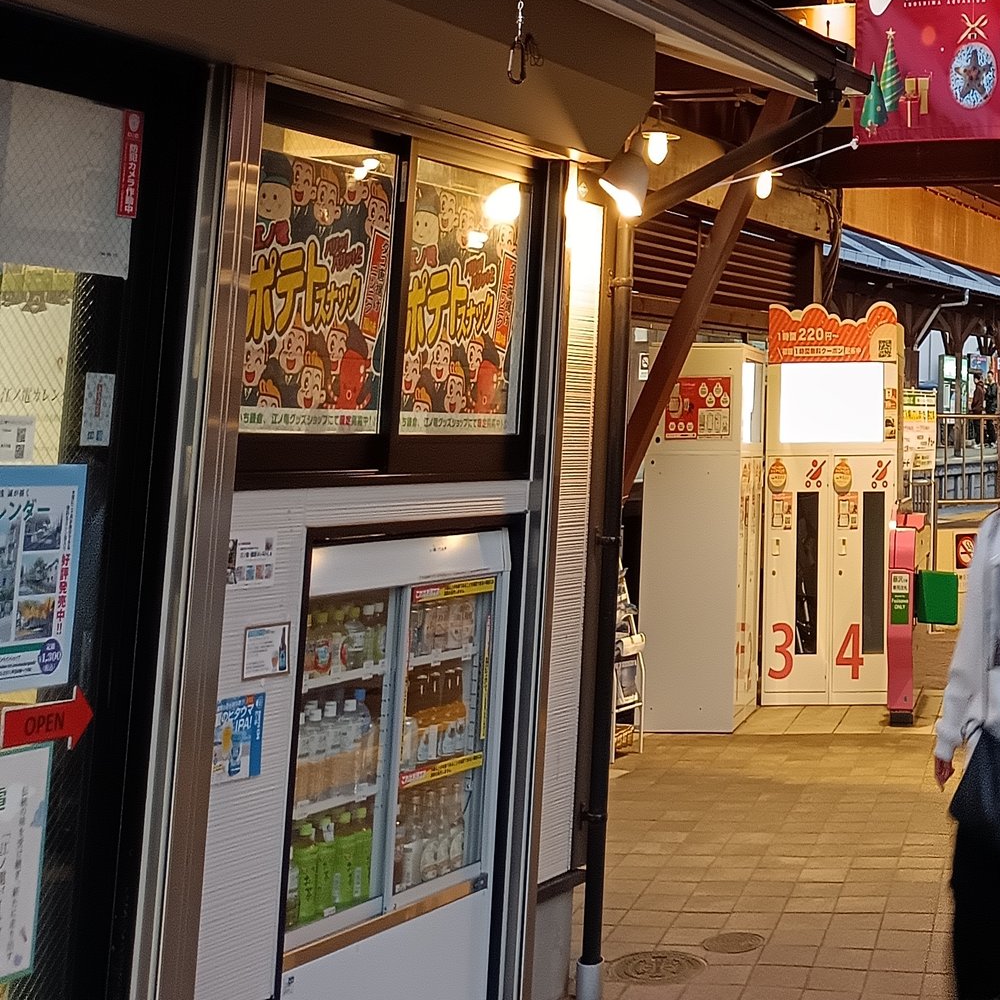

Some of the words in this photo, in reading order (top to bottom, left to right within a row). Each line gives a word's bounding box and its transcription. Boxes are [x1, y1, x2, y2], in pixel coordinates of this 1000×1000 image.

[245, 239, 363, 344] ポテトスナック
[406, 261, 494, 356] ポテトスナック
[55, 553, 71, 635] 好評発売中!!
[768, 623, 794, 680] 3
[836, 624, 864, 680] 4
[24, 711, 65, 737] OPEN
